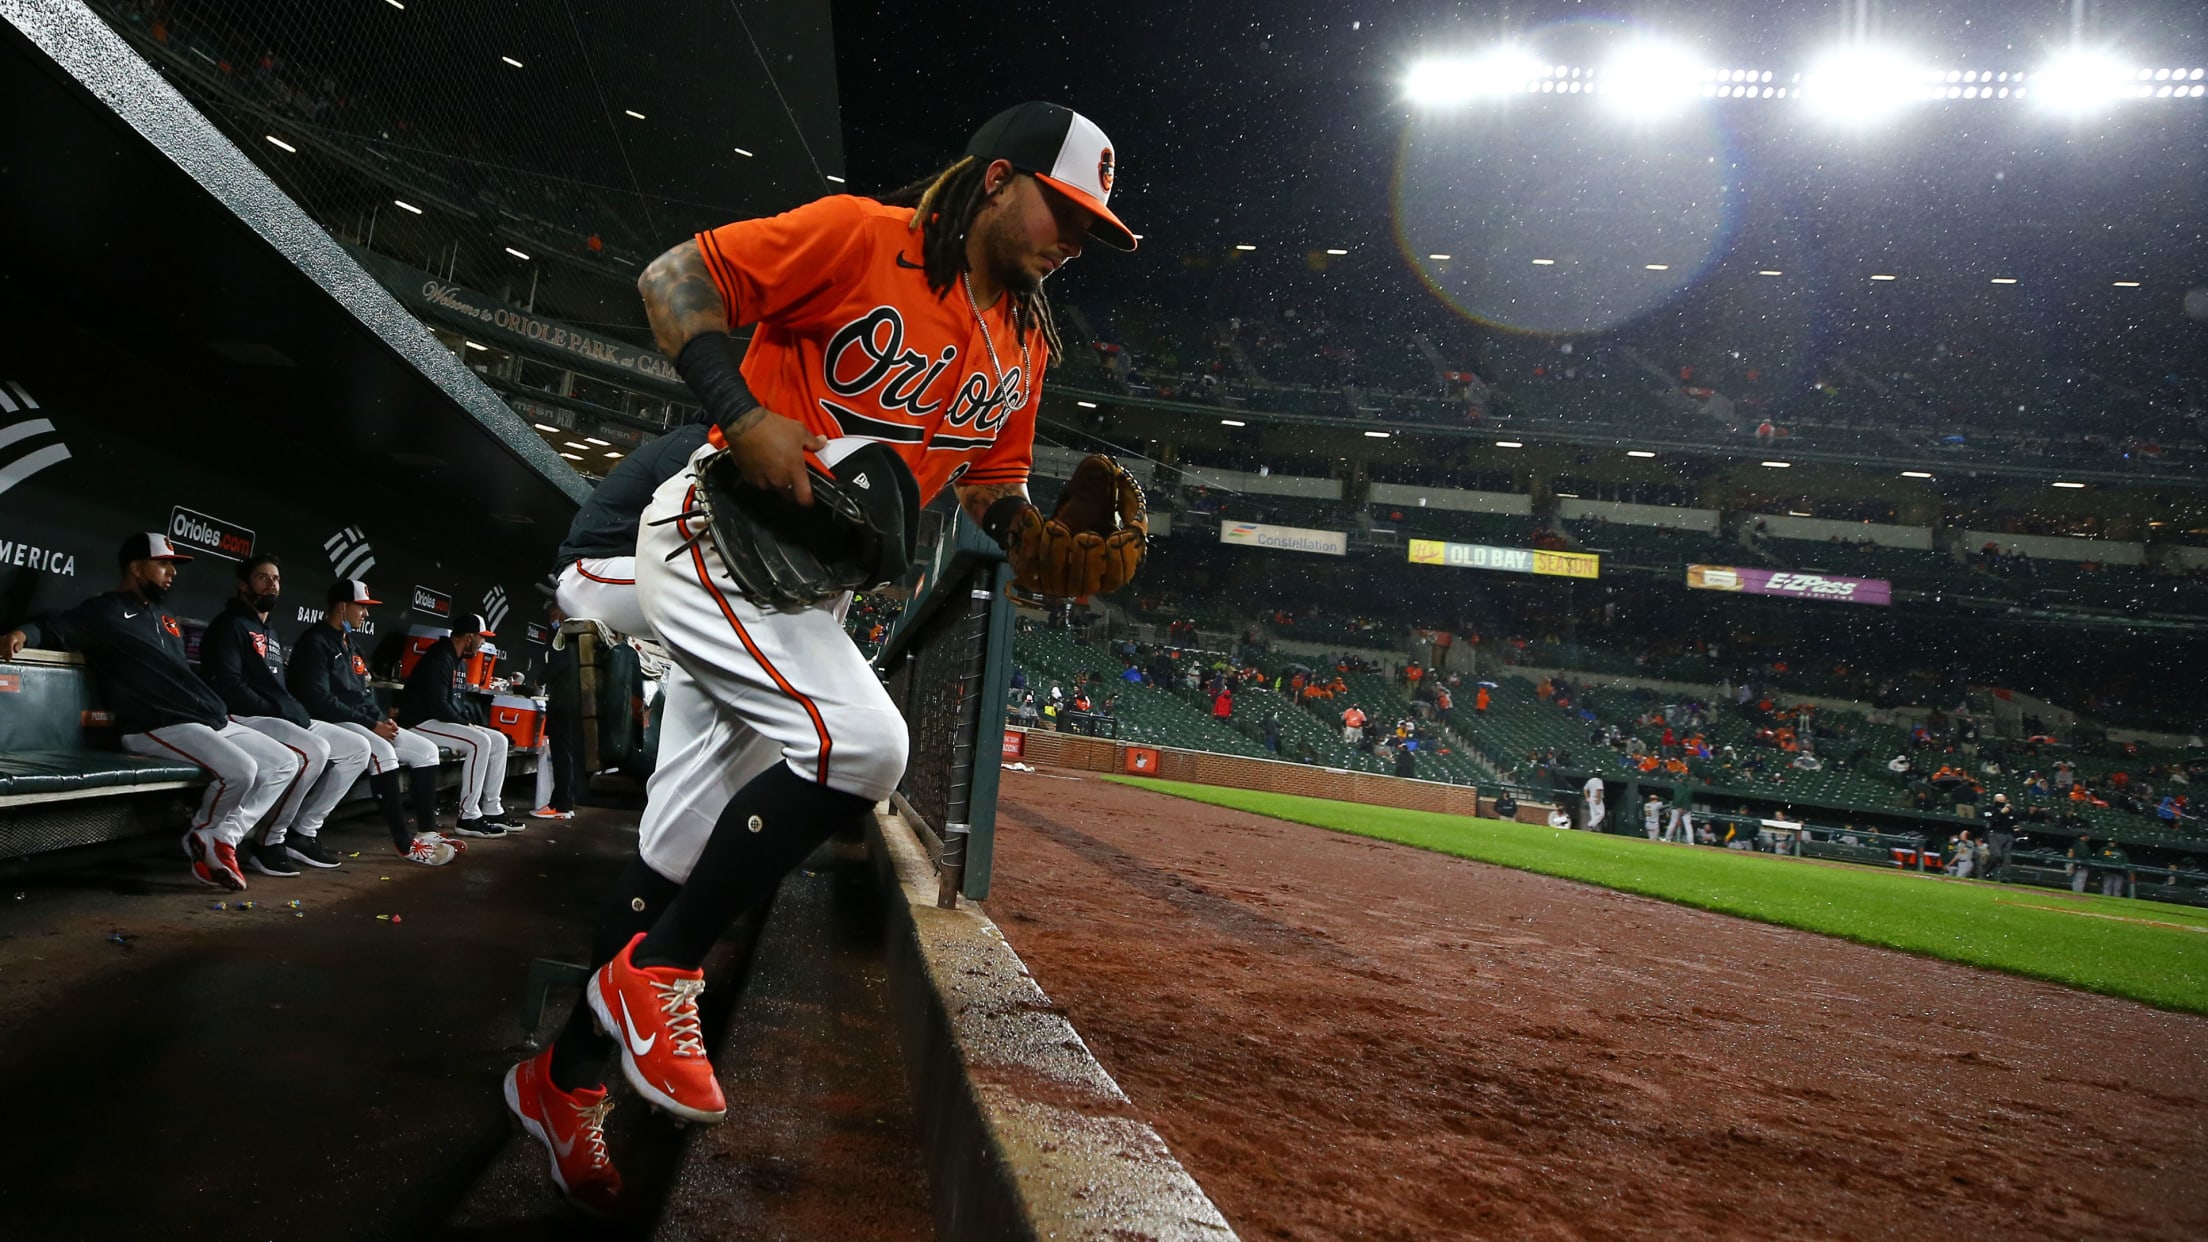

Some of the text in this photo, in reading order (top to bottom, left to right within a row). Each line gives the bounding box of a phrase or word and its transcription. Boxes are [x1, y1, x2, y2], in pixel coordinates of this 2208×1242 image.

[422, 280, 482, 318] Welcome
[495, 308, 568, 348] ORIOLE
[568, 332, 619, 364] PARK
[823, 304, 1021, 433] Oriole
[173, 513, 252, 557] Orioles.com
[1256, 533, 1338, 553] Constellation
[1450, 545, 1486, 566] OLD
[1491, 549, 1528, 569] BAY
[1538, 553, 1594, 575] SEASON
